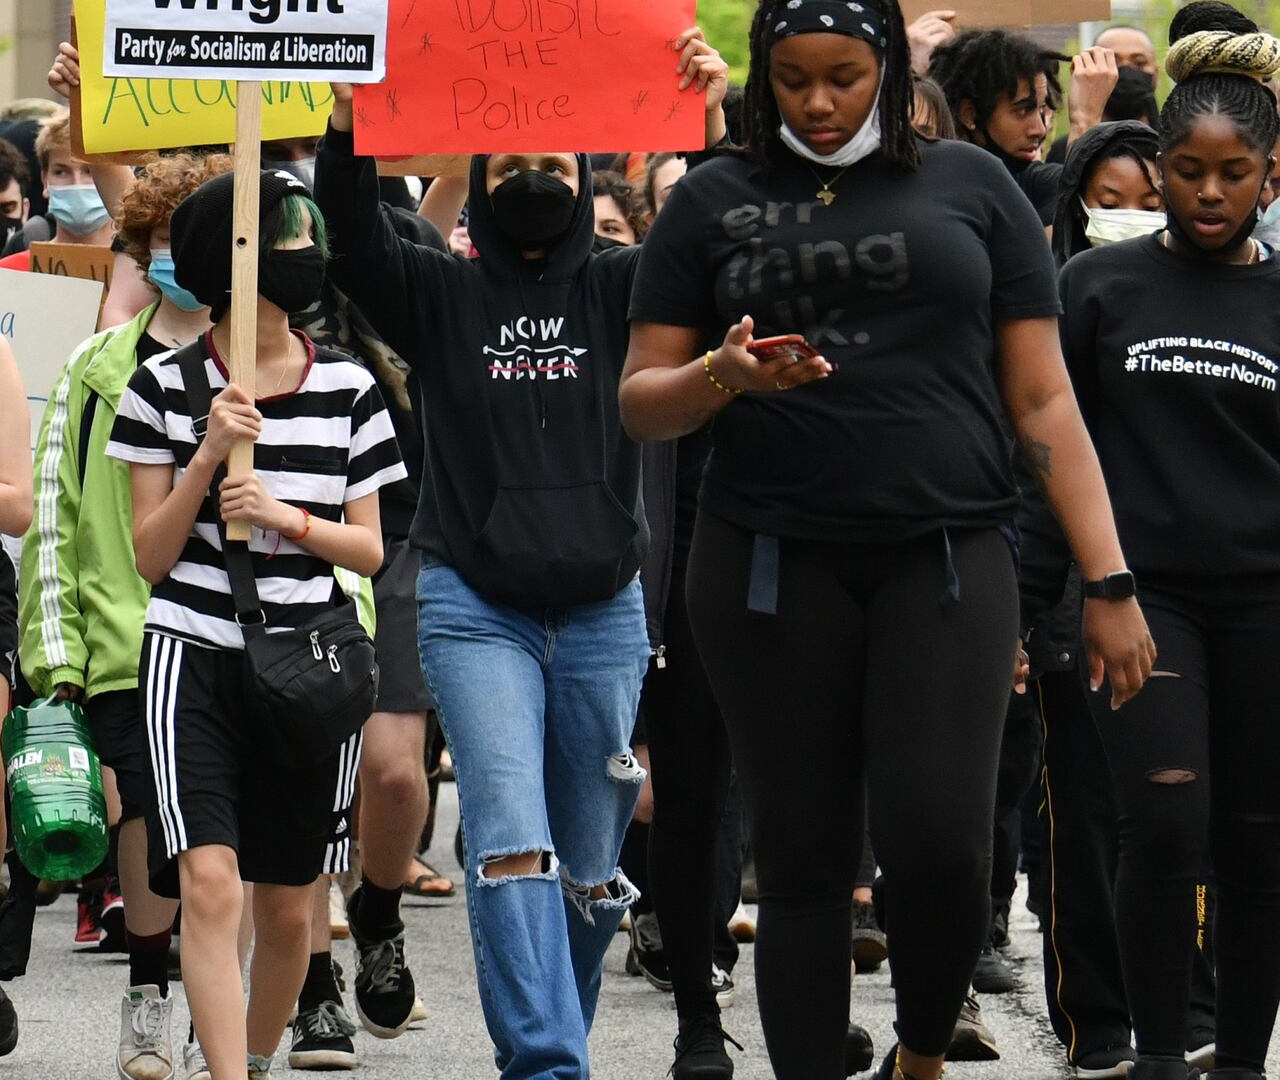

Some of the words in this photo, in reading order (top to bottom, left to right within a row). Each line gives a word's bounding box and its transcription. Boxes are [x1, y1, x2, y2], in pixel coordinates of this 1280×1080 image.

[120, 32, 165, 66] Party
[166, 38, 188, 63] for
[190, 35, 267, 62] Socialism
[269, 40, 282, 62] &
[284, 37, 367, 64] Liberation
[467, 38, 559, 70] THE
[452, 77, 576, 131] Police
[722, 201, 825, 240] err
[500, 316, 565, 346] NOW
[492, 355, 578, 381] NEVER
[1124, 354, 1277, 392] #TheBetterNorm
[1127, 337, 1188, 356] UPLIFTING
[1190, 337, 1231, 353] BLACK
[1231, 343, 1279, 374] HISTORY
